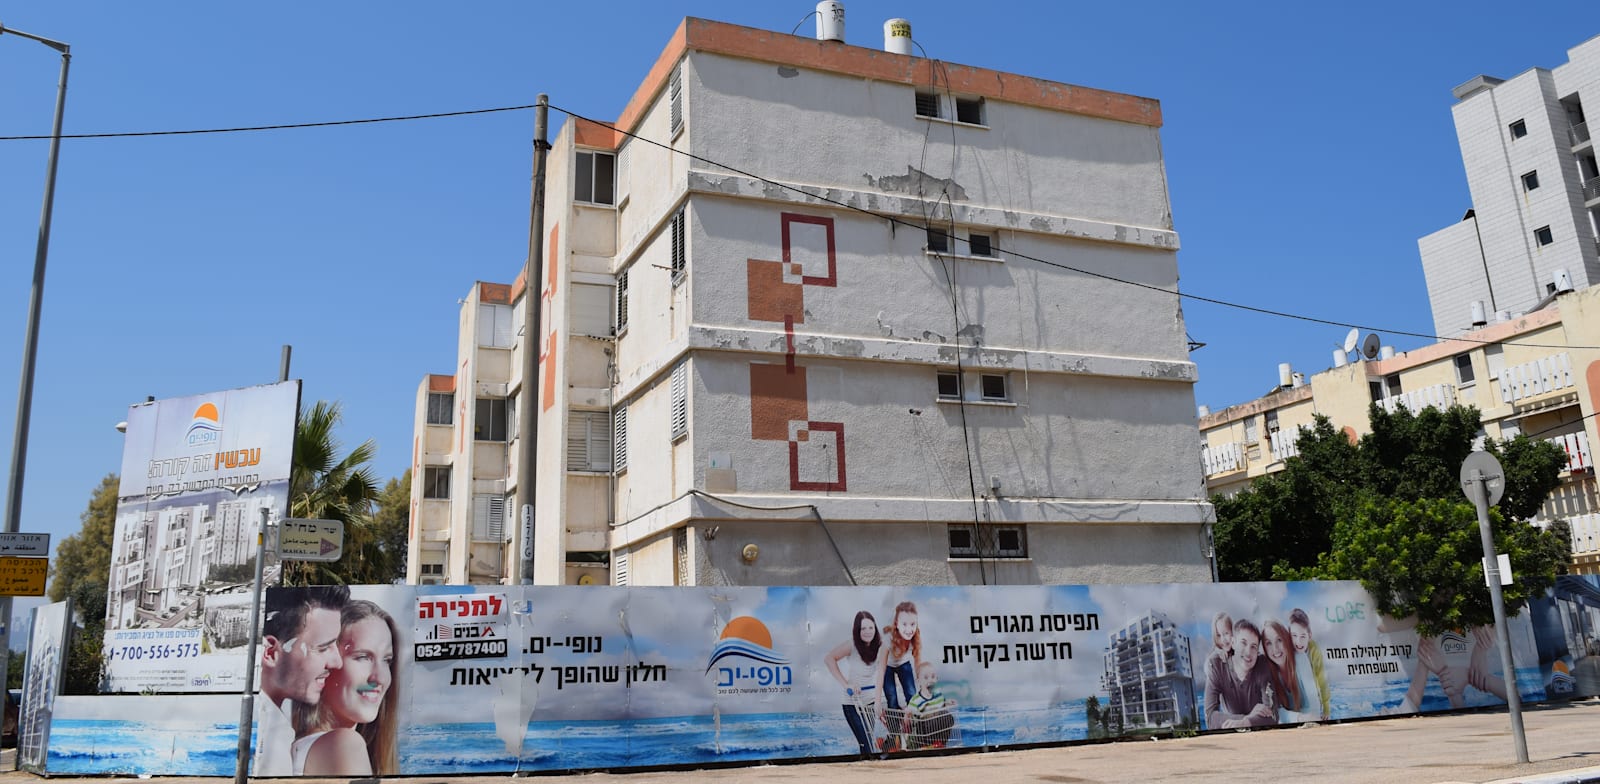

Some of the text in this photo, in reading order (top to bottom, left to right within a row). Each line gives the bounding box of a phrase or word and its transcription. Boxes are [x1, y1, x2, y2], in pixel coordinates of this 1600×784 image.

[148, 448, 261, 480] עכשיו זה קורה!
[419, 595, 502, 619] למכירה
[970, 613, 1099, 633] תפיסת מגורים
[110, 643, 199, 661] 1-700-556-575
[416, 641, 506, 658] 052-7787400
[942, 642, 1072, 669] חדשה בקריות
[1326, 643, 1412, 661] קרוב לקהילה חמה
[551, 664, 619, 690] שהופך
[625, 661, 667, 688] חלון
[1347, 661, 1399, 676] ומשפחתית
